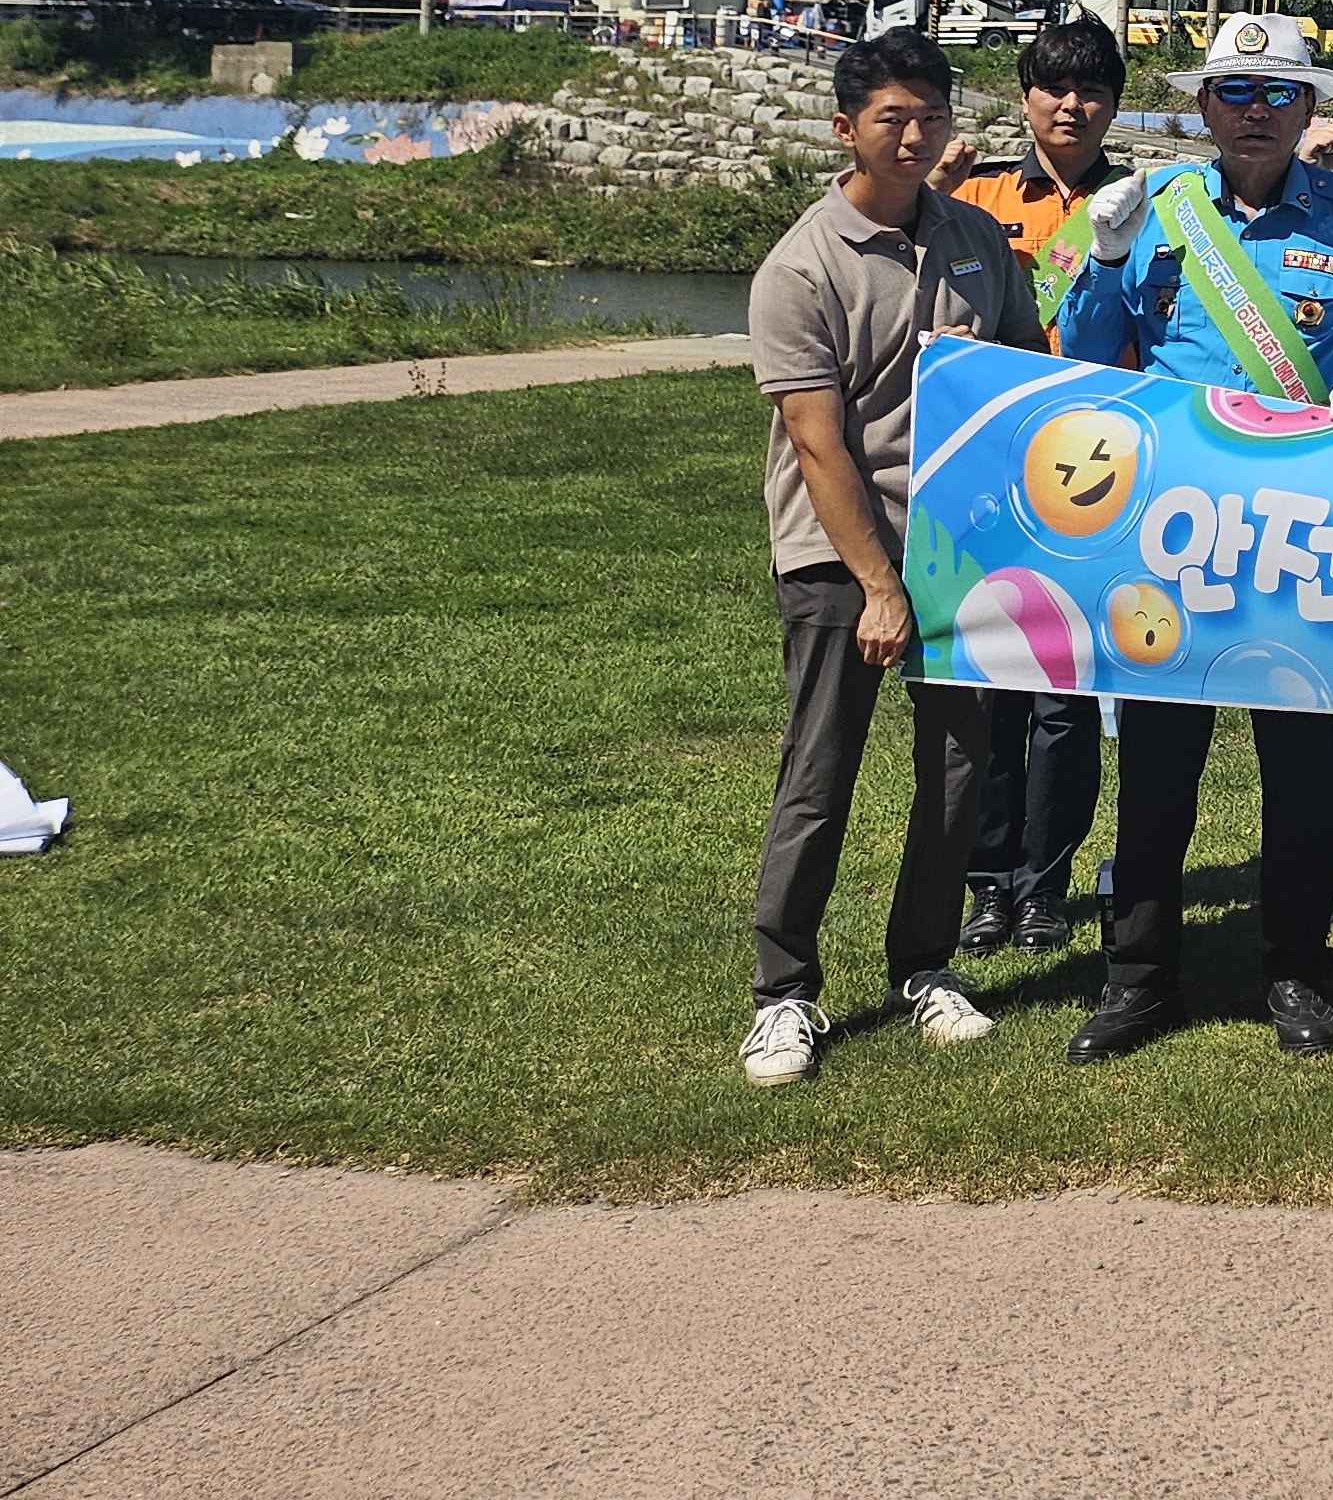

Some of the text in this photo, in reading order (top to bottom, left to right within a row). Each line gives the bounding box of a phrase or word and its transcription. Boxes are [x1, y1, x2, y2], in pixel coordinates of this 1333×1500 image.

[1174, 197, 1211, 254] 생명을
[1201, 247, 1248, 309] 지키는
[1236, 303, 1285, 363] 안전한
